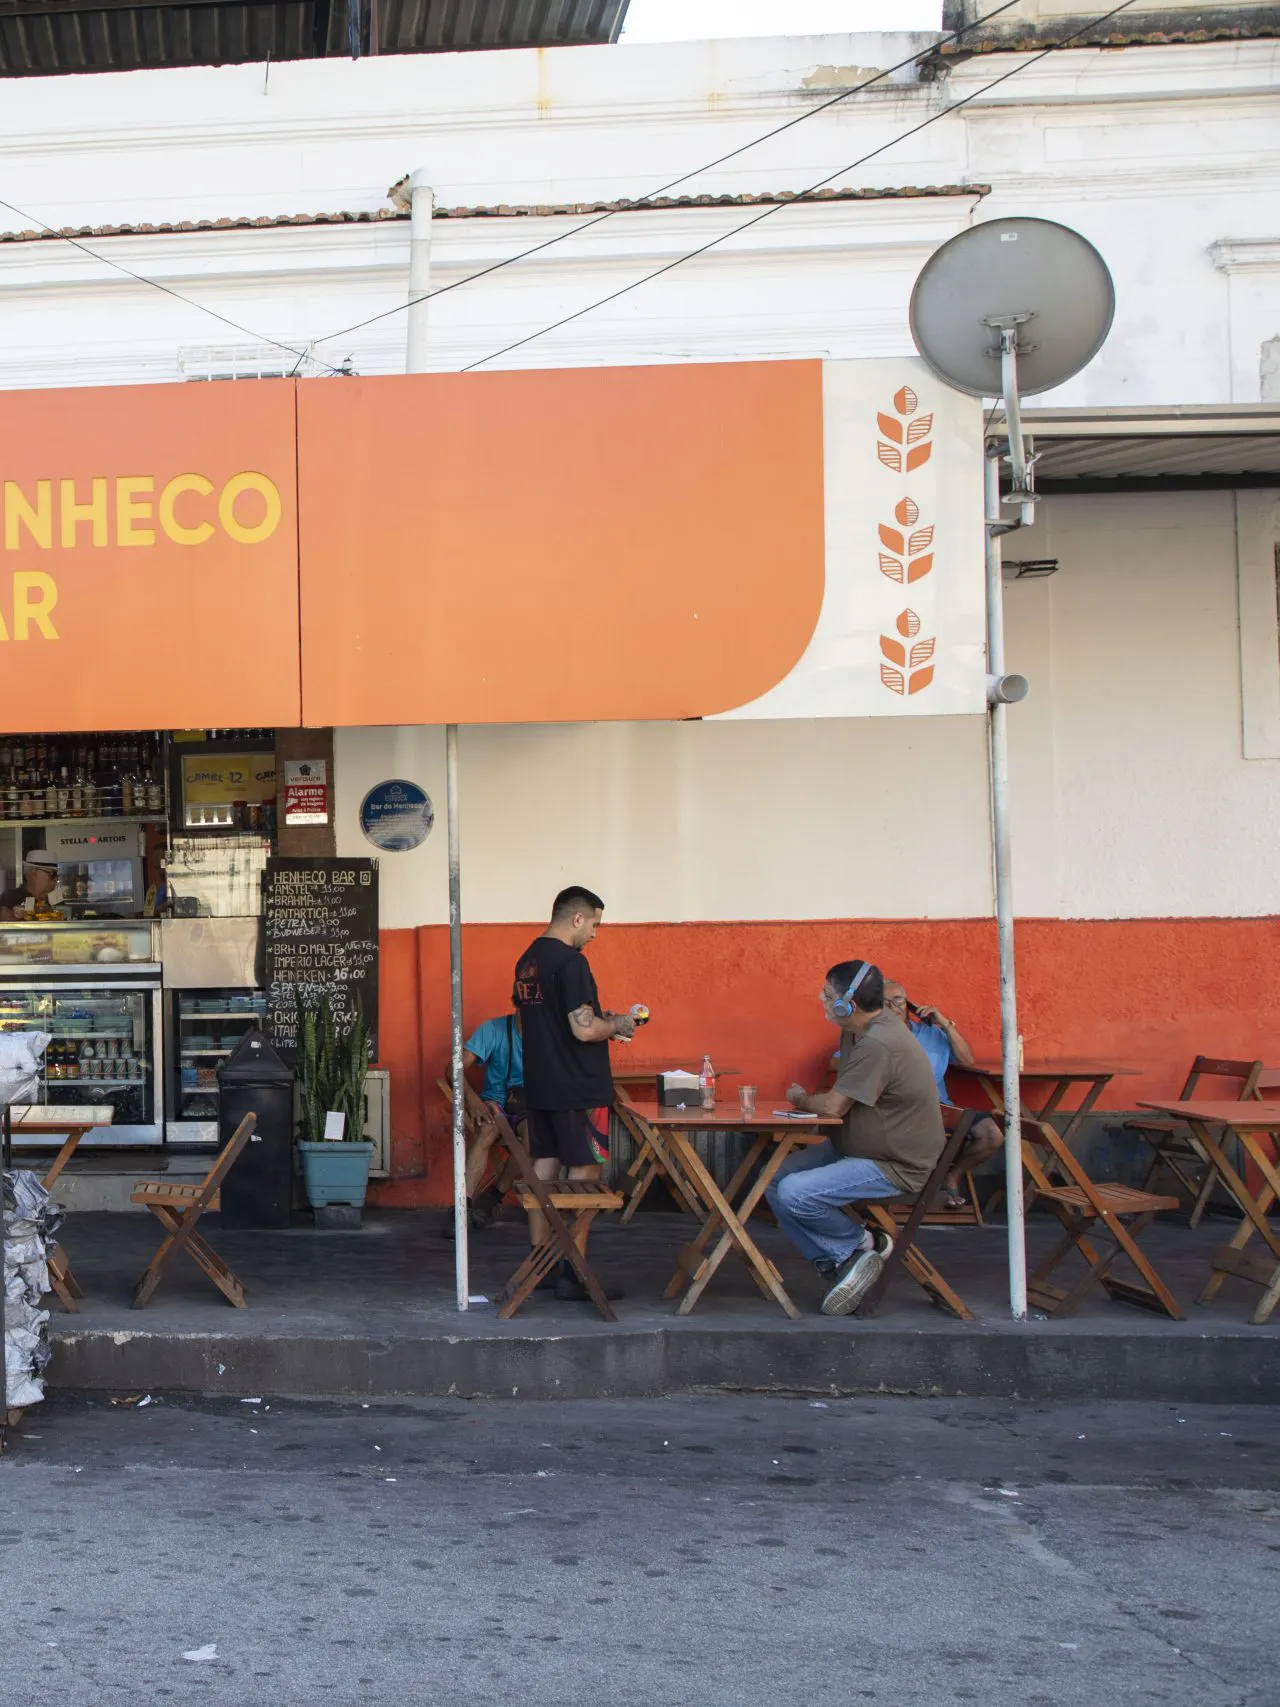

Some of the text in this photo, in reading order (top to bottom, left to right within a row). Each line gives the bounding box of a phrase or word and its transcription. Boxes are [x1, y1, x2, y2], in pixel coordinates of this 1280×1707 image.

[288, 787, 324, 797] Alarme
[61, 835, 126, 845] STELLA ARTOIS
[274, 871, 355, 883] HENHECO BAR
[275, 885, 311, 895] AMSTEL
[275, 895, 314, 906] BRAHMA
[275, 907, 328, 919] ANTARTICA
[271, 919, 307, 929] PETRA
[315, 956, 346, 967] LAGER
[273, 970, 326, 982] HEINEKEN
[271, 982, 312, 992] SPAEN
